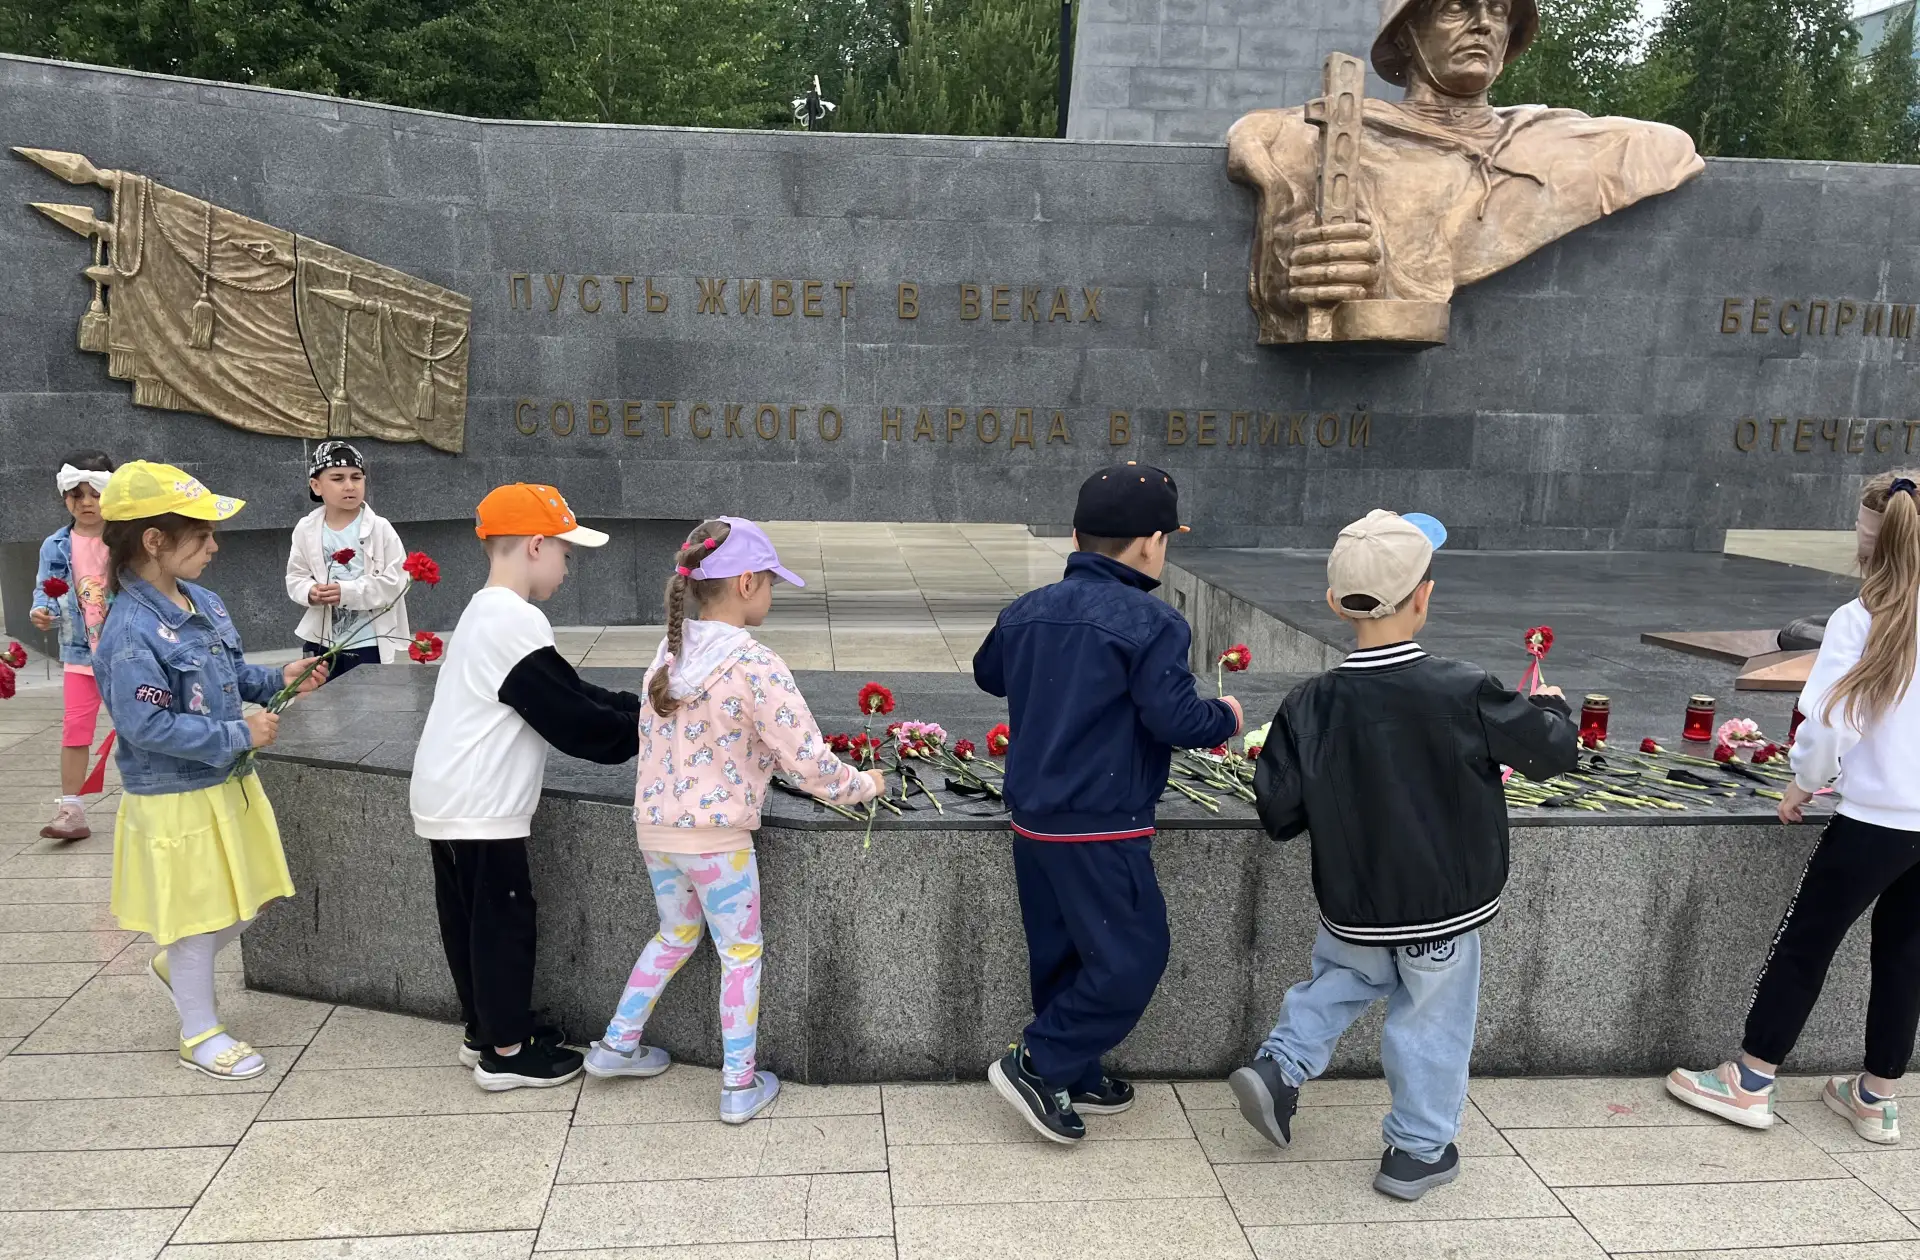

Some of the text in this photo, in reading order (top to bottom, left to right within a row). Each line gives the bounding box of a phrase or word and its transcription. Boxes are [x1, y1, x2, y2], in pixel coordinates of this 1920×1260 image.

[509, 273, 1916, 338] ПУСТЬ ЖИВЕТ В ВЕКАХ БЕСПРИМ
[515, 400, 1920, 453] СОВЕТСКОГО НАРОДА В ВЕЛИКОЙ ОТЕЧЕСТ
